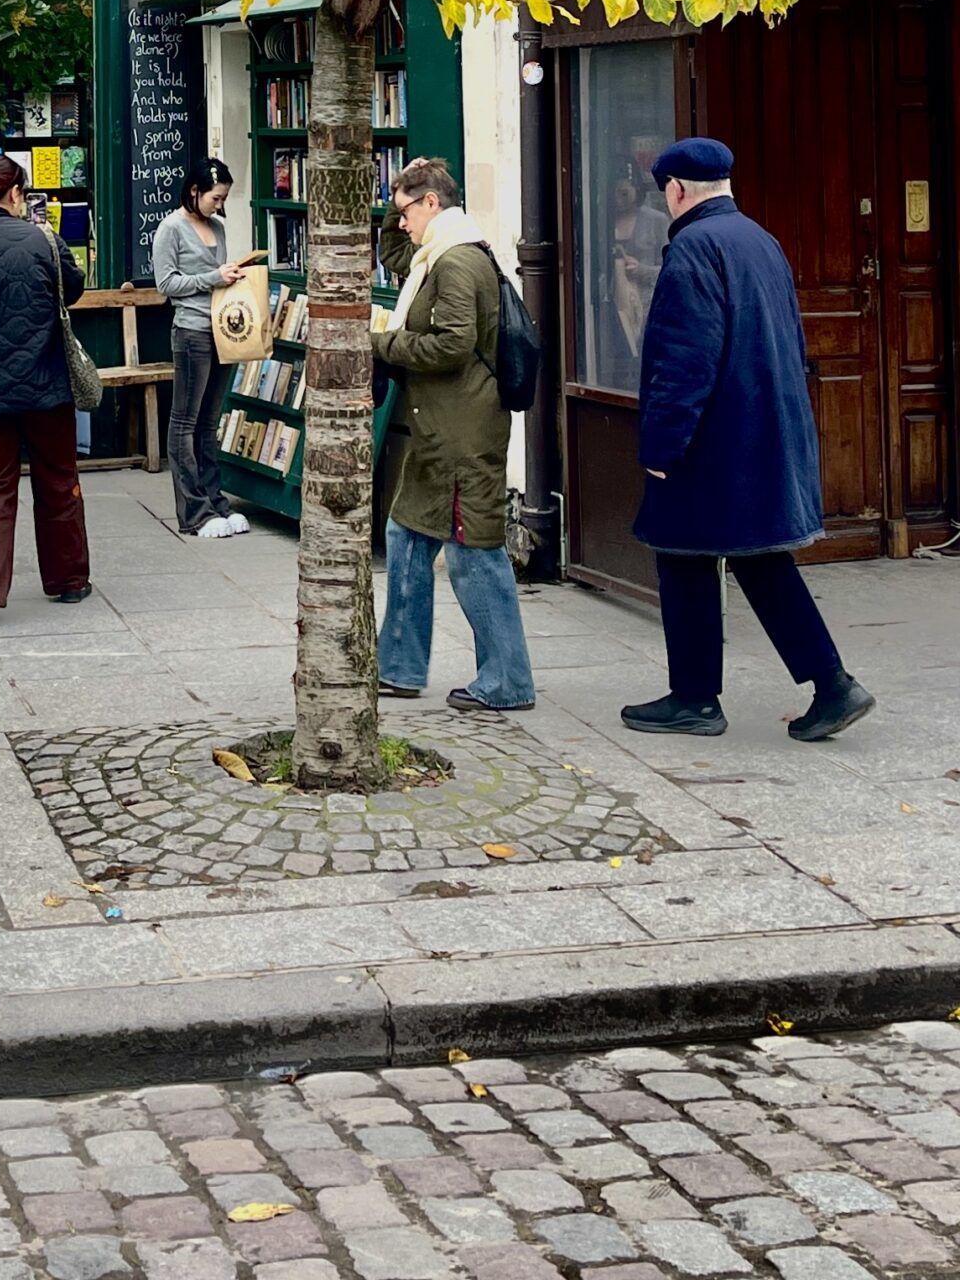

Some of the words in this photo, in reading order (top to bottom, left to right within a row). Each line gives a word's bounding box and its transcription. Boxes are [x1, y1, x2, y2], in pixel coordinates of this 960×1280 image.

[128, 8, 141, 27] (Is
[143, 9, 152, 26] it
[155, 9, 186, 32] night?
[129, 29, 146, 44] Are
[148, 33, 161, 43] we
[161, 30, 183, 43] here
[135, 43, 179, 59] alone?)
[132, 60, 141, 75] It
[148, 59, 160, 73] is
[166, 57, 171, 74] I
[135, 78, 155, 93] you
[131, 92, 157, 108] And
[162, 90, 183, 105] who
[137, 108, 166, 124] holds
[133, 129, 139, 146] I
[145, 129, 185, 151] spring
[141, 146, 172, 166] from
[132, 165, 151, 181] the
[154, 165, 185, 187] pages
[143, 187, 172, 206] into
[139, 209, 172, 231] your
